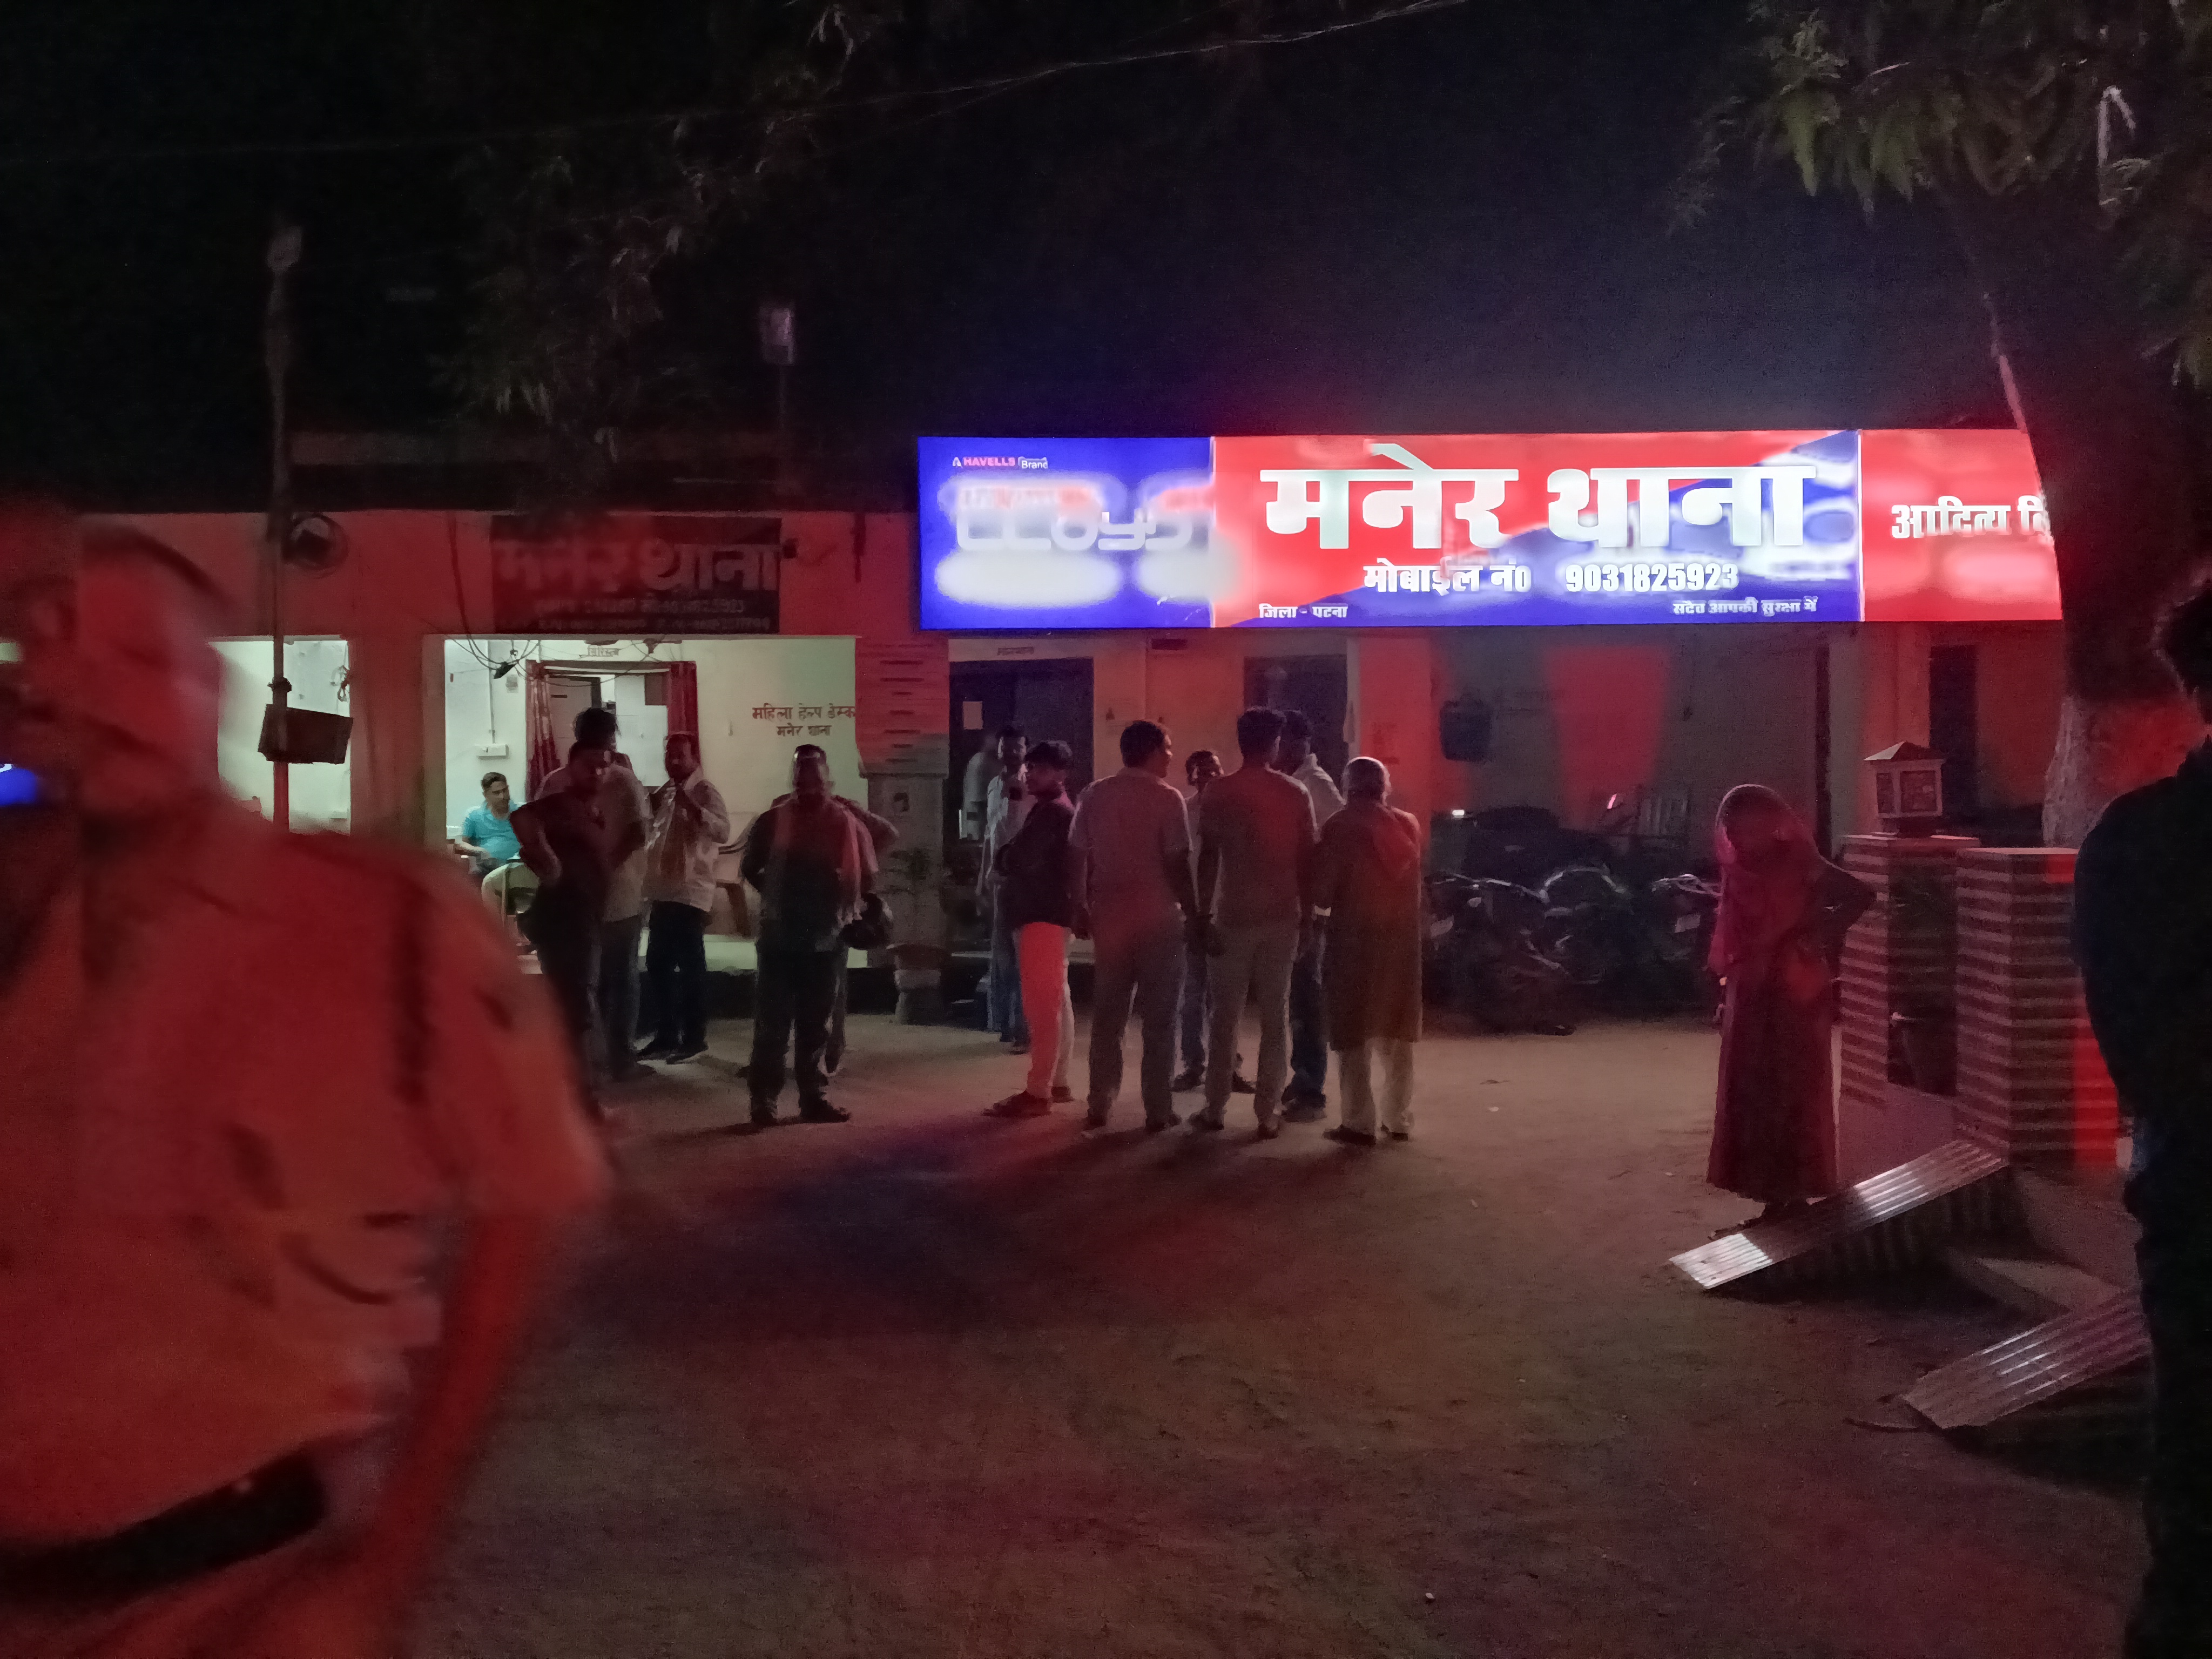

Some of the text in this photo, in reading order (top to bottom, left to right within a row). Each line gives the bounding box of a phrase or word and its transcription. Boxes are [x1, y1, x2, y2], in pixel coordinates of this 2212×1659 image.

[963, 456, 1015, 467] HAVELLS
[1259, 440, 1817, 549] मनेर थाना
[1891, 495, 2011, 538] आदित्य
[1566, 563, 1739, 592] 9031825923
[1258, 603, 1298, 618] जिला
[1312, 604, 1348, 618] पटना
[1708, 596, 1758, 613] आपकी
[1761, 599, 1802, 617] सुरक्षा
[752, 703, 793, 721] महिला
[777, 723, 804, 737] मनेर
